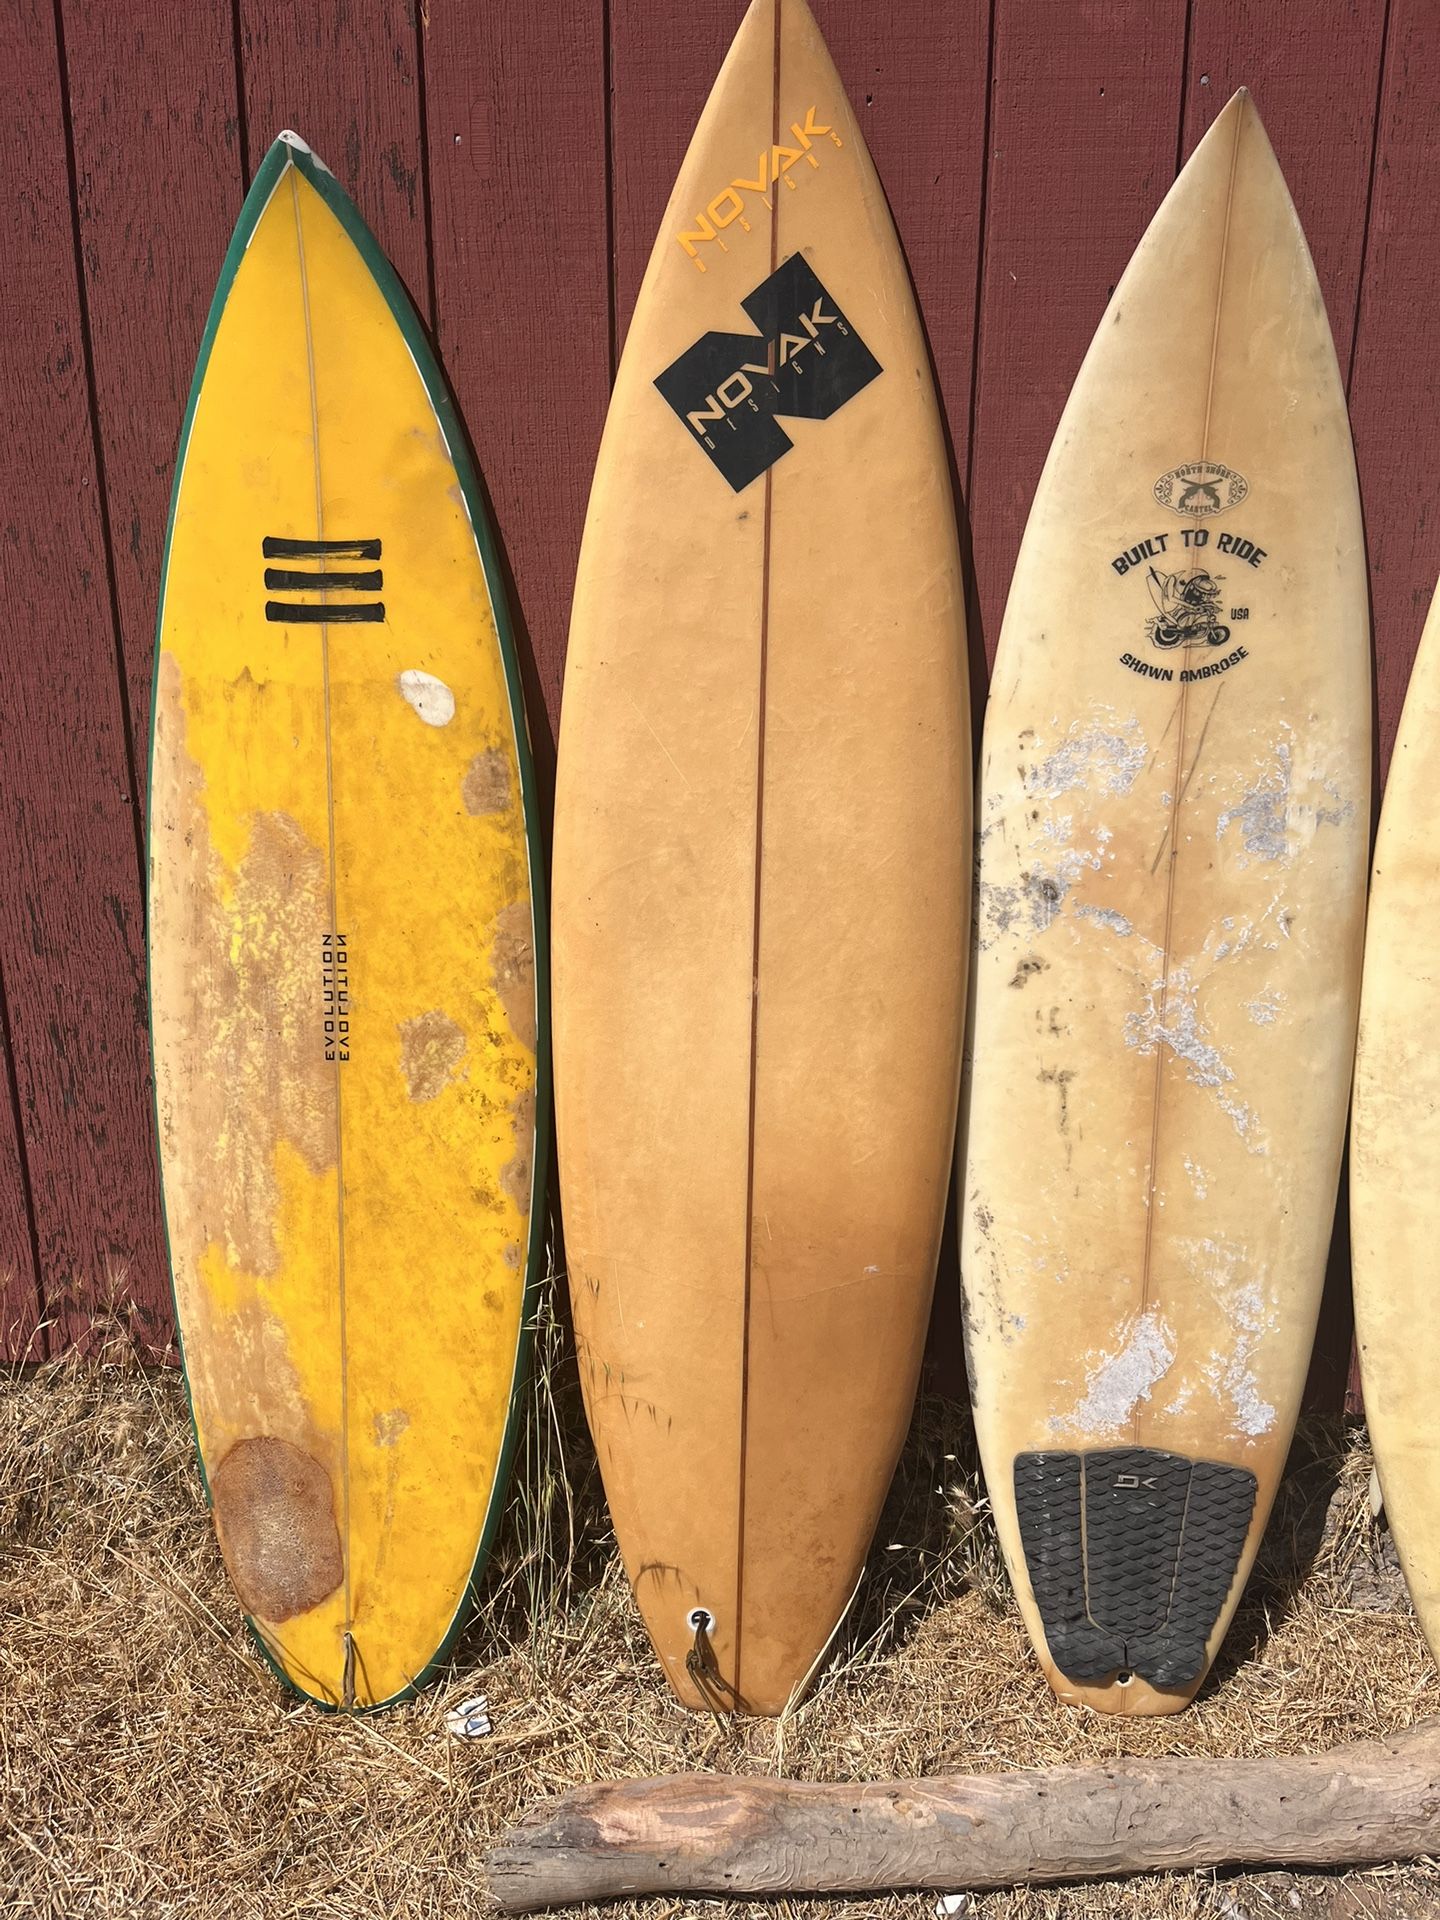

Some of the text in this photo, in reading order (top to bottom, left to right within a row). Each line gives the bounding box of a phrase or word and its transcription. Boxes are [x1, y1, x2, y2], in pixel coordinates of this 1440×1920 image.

[675, 105, 833, 258] NOVAK
[686, 296, 839, 435] NOVAK
[1174, 465, 1231, 479] NORTH SHORE
[1111, 529, 1268, 576] BUILT TO RIDE
[1230, 608, 1249, 620] USA
[1119, 645, 1249, 682] SHAWN AMBROSE
[322, 934, 335, 1061] EVOLUTION
